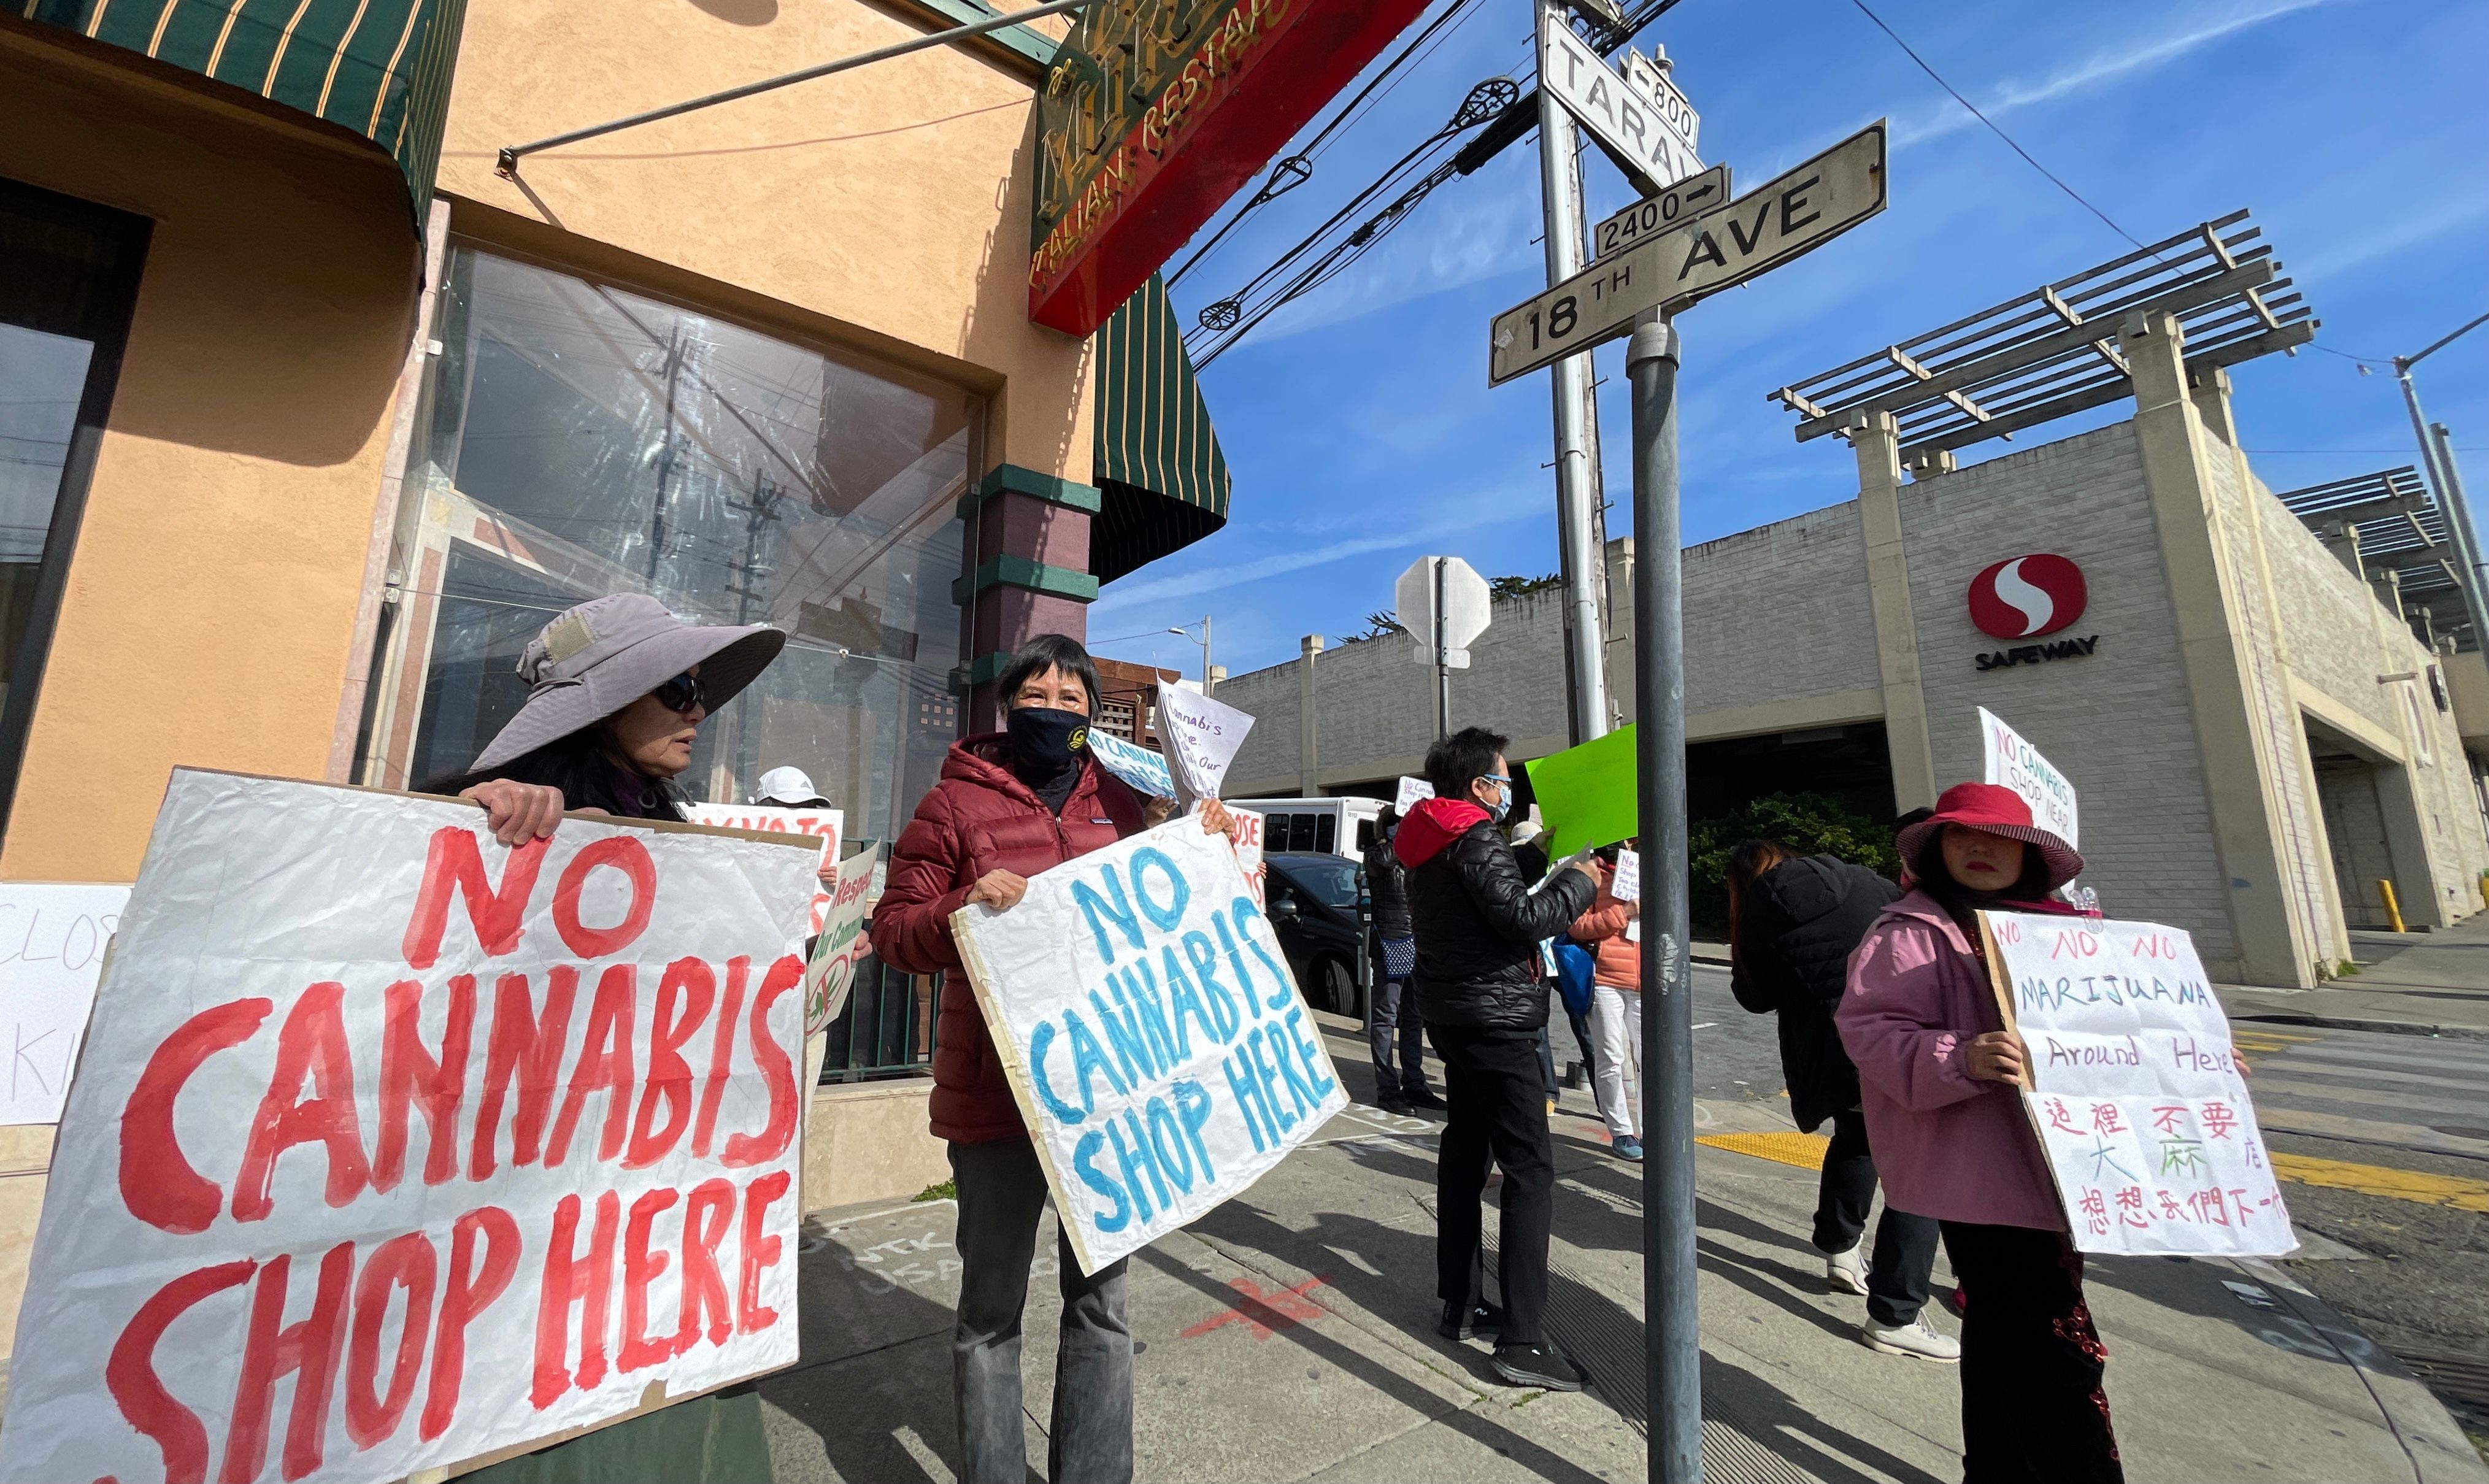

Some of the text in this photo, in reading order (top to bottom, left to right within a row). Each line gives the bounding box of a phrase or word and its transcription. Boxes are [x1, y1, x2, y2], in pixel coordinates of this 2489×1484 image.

[1653, 78, 1691, 138] 800
[1604, 191, 1680, 250] 2400
[1677, 175, 1821, 281] AVE
[1975, 635, 2099, 671] SAFEWAY
[1168, 693, 1221, 736] Cannabis
[1199, 756, 1221, 771] Our
[1996, 726, 2068, 805] NO CANNABIS
[2010, 767, 2069, 837] SHOP NEAR
[832, 869, 874, 909] Respec
[1620, 867, 1637, 879] Shop
[1622, 855, 1634, 867] No
[404, 826, 656, 970] NO
[1069, 847, 1191, 964] NO
[813, 929, 833, 963] Our
[1997, 920, 2177, 960] NO NO NO
[1030, 896, 1295, 1125] CANNABIS
[2022, 974, 2211, 1012] MARIJUANA
[2045, 1035, 2233, 1074] Around Here
[119, 953, 804, 1236] CANNABIS
[1072, 1005, 1334, 1233] SHOP HERE
[92, 1171, 790, 1484] SHOP HERE
